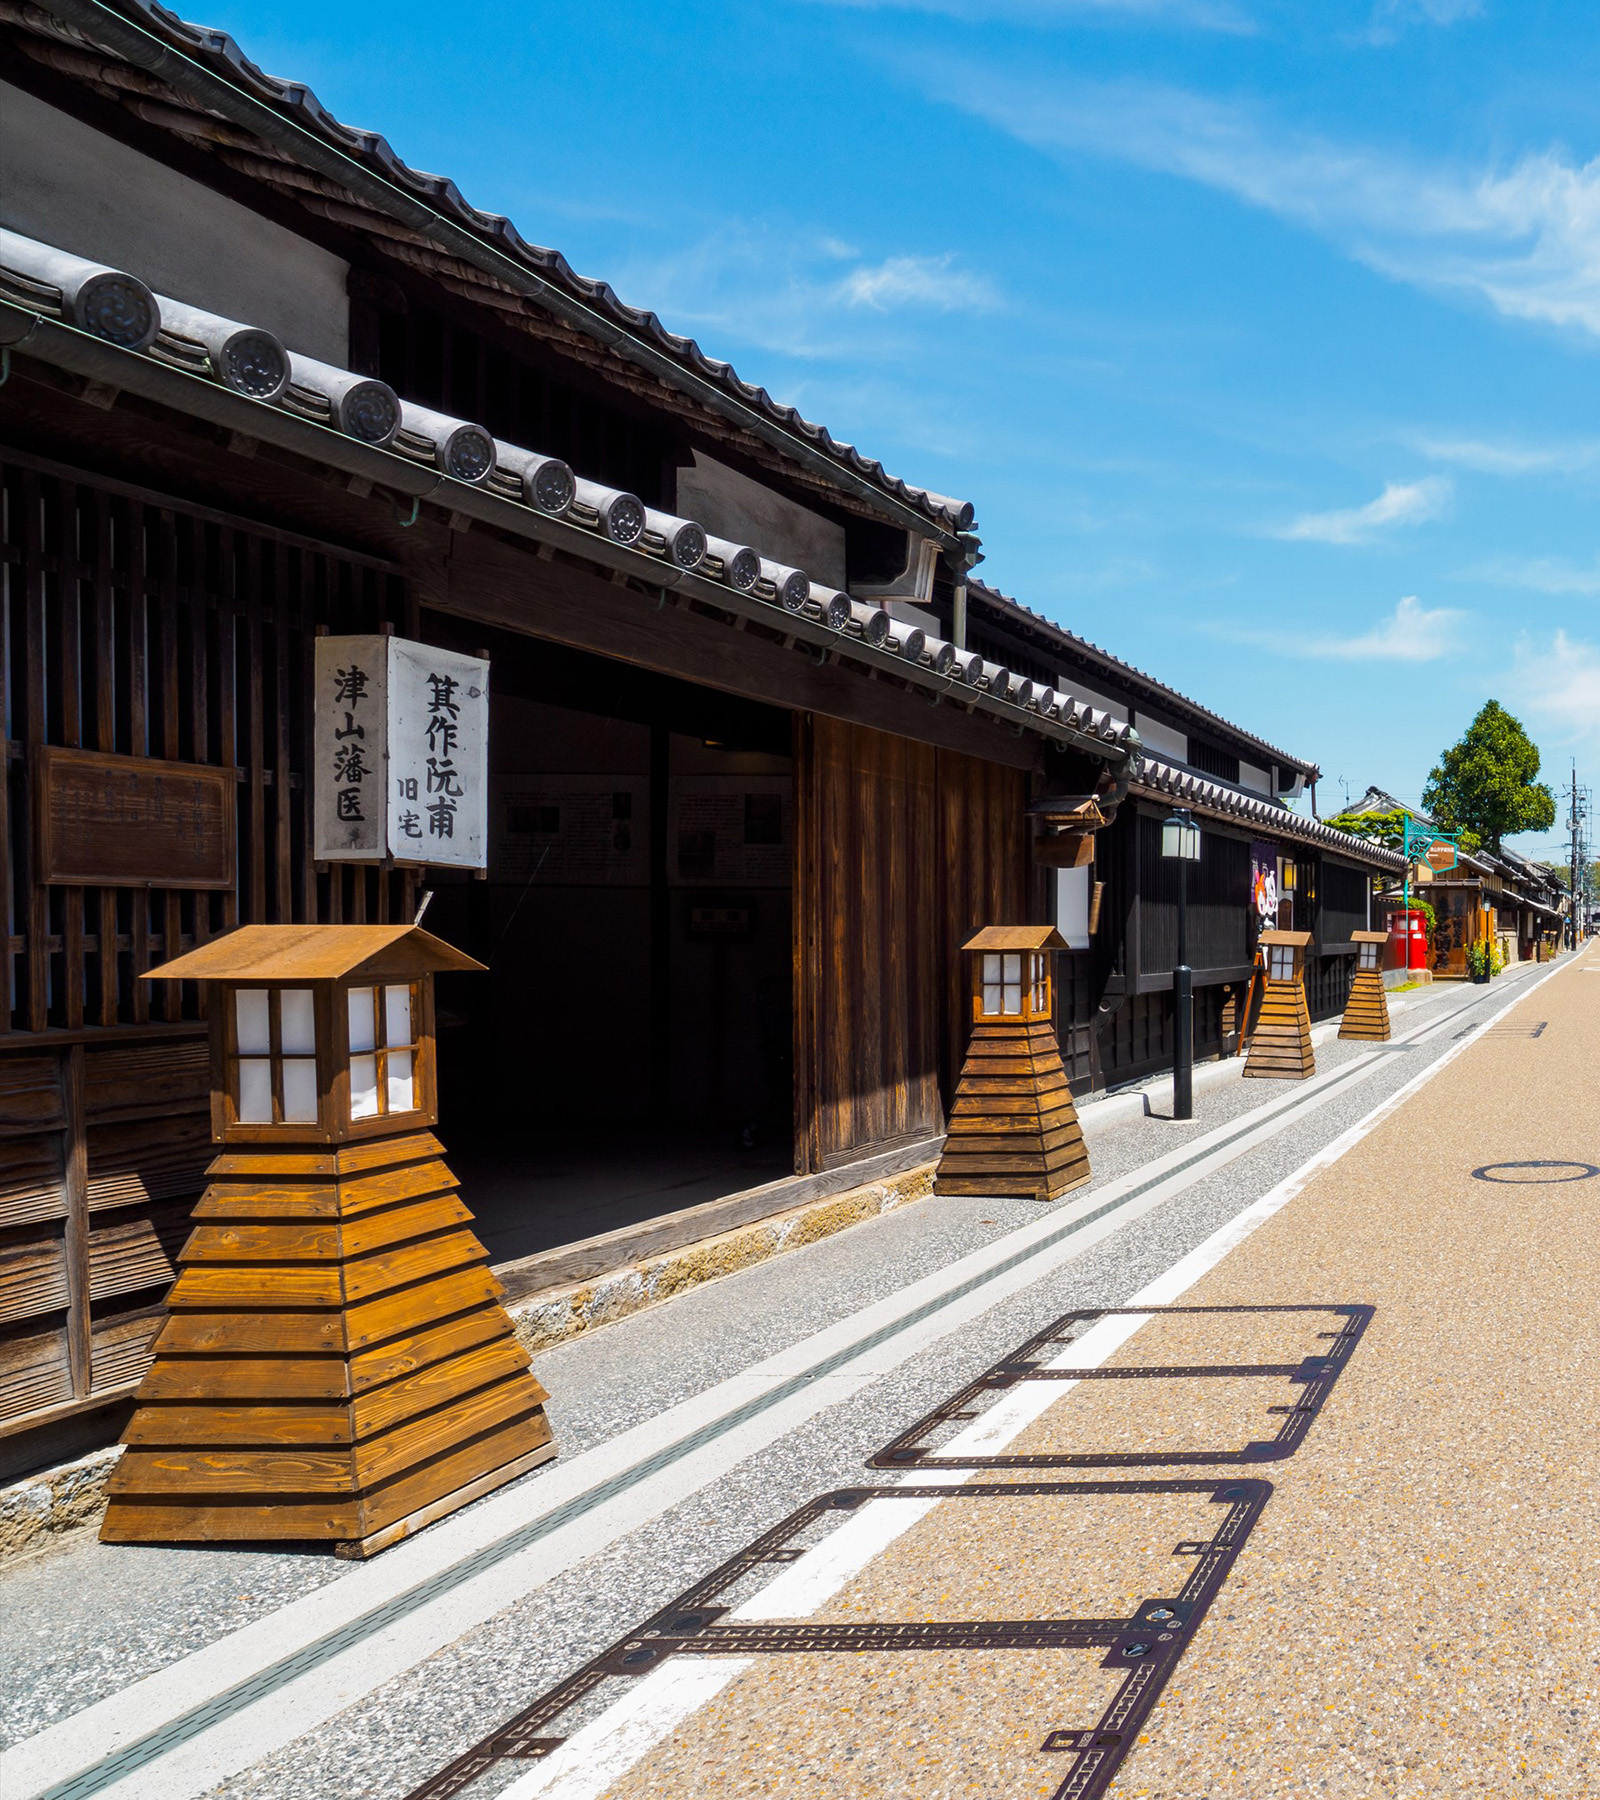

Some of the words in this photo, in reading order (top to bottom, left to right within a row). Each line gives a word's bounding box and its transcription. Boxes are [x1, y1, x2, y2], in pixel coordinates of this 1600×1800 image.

[334, 665, 372, 822] 津山藩医
[397, 777, 424, 839] 旧宅
[424, 673, 464, 840] 箕作阮甫
